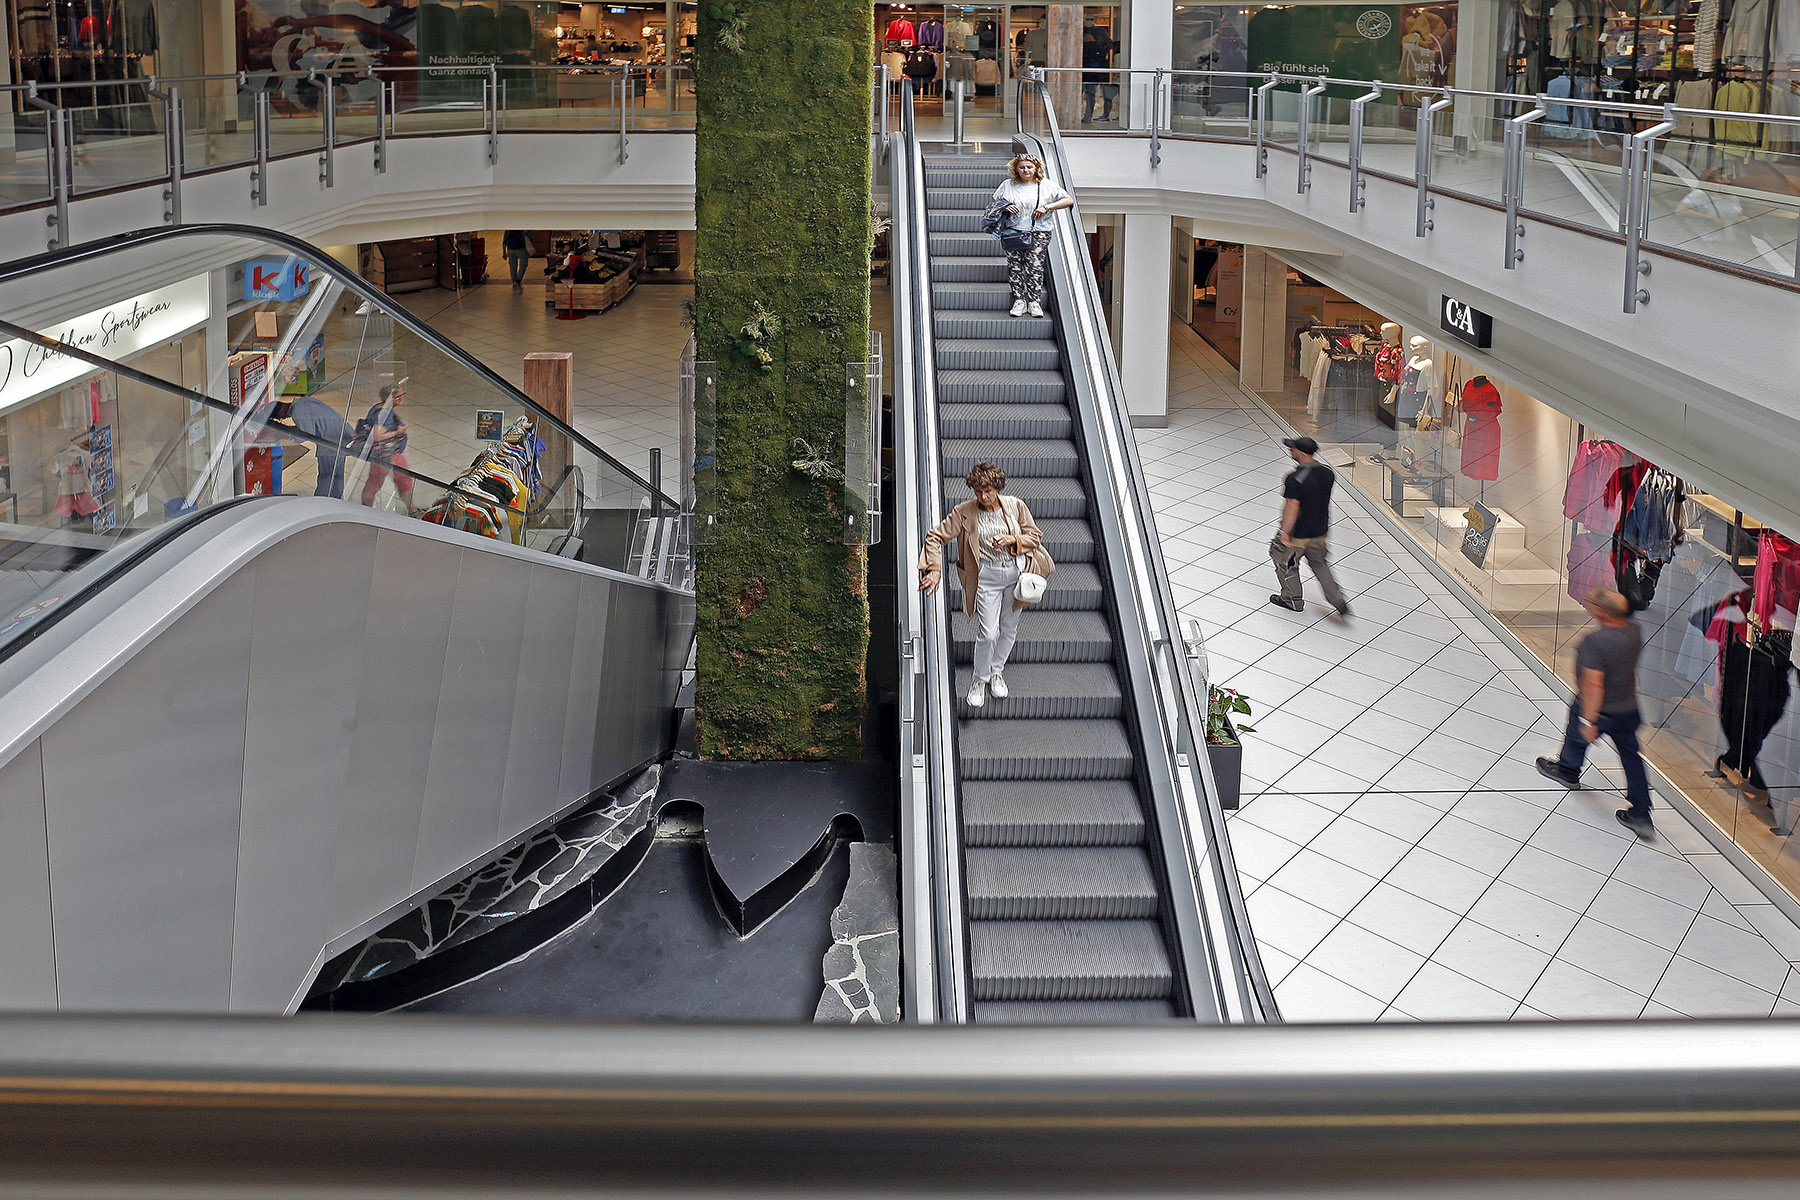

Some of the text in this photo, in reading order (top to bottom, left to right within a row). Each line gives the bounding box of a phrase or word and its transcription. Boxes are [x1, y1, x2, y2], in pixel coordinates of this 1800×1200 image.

[429, 55, 504, 65] Nachhaltigkeit.
[429, 67, 490, 76] Ganz einfac
[1263, 63, 1330, 73] Bio fühlt sich
[252, 291, 280, 299] kiosk
[1446, 298, 1475, 336] C&A
[101, 301, 172, 348] Sportswear
